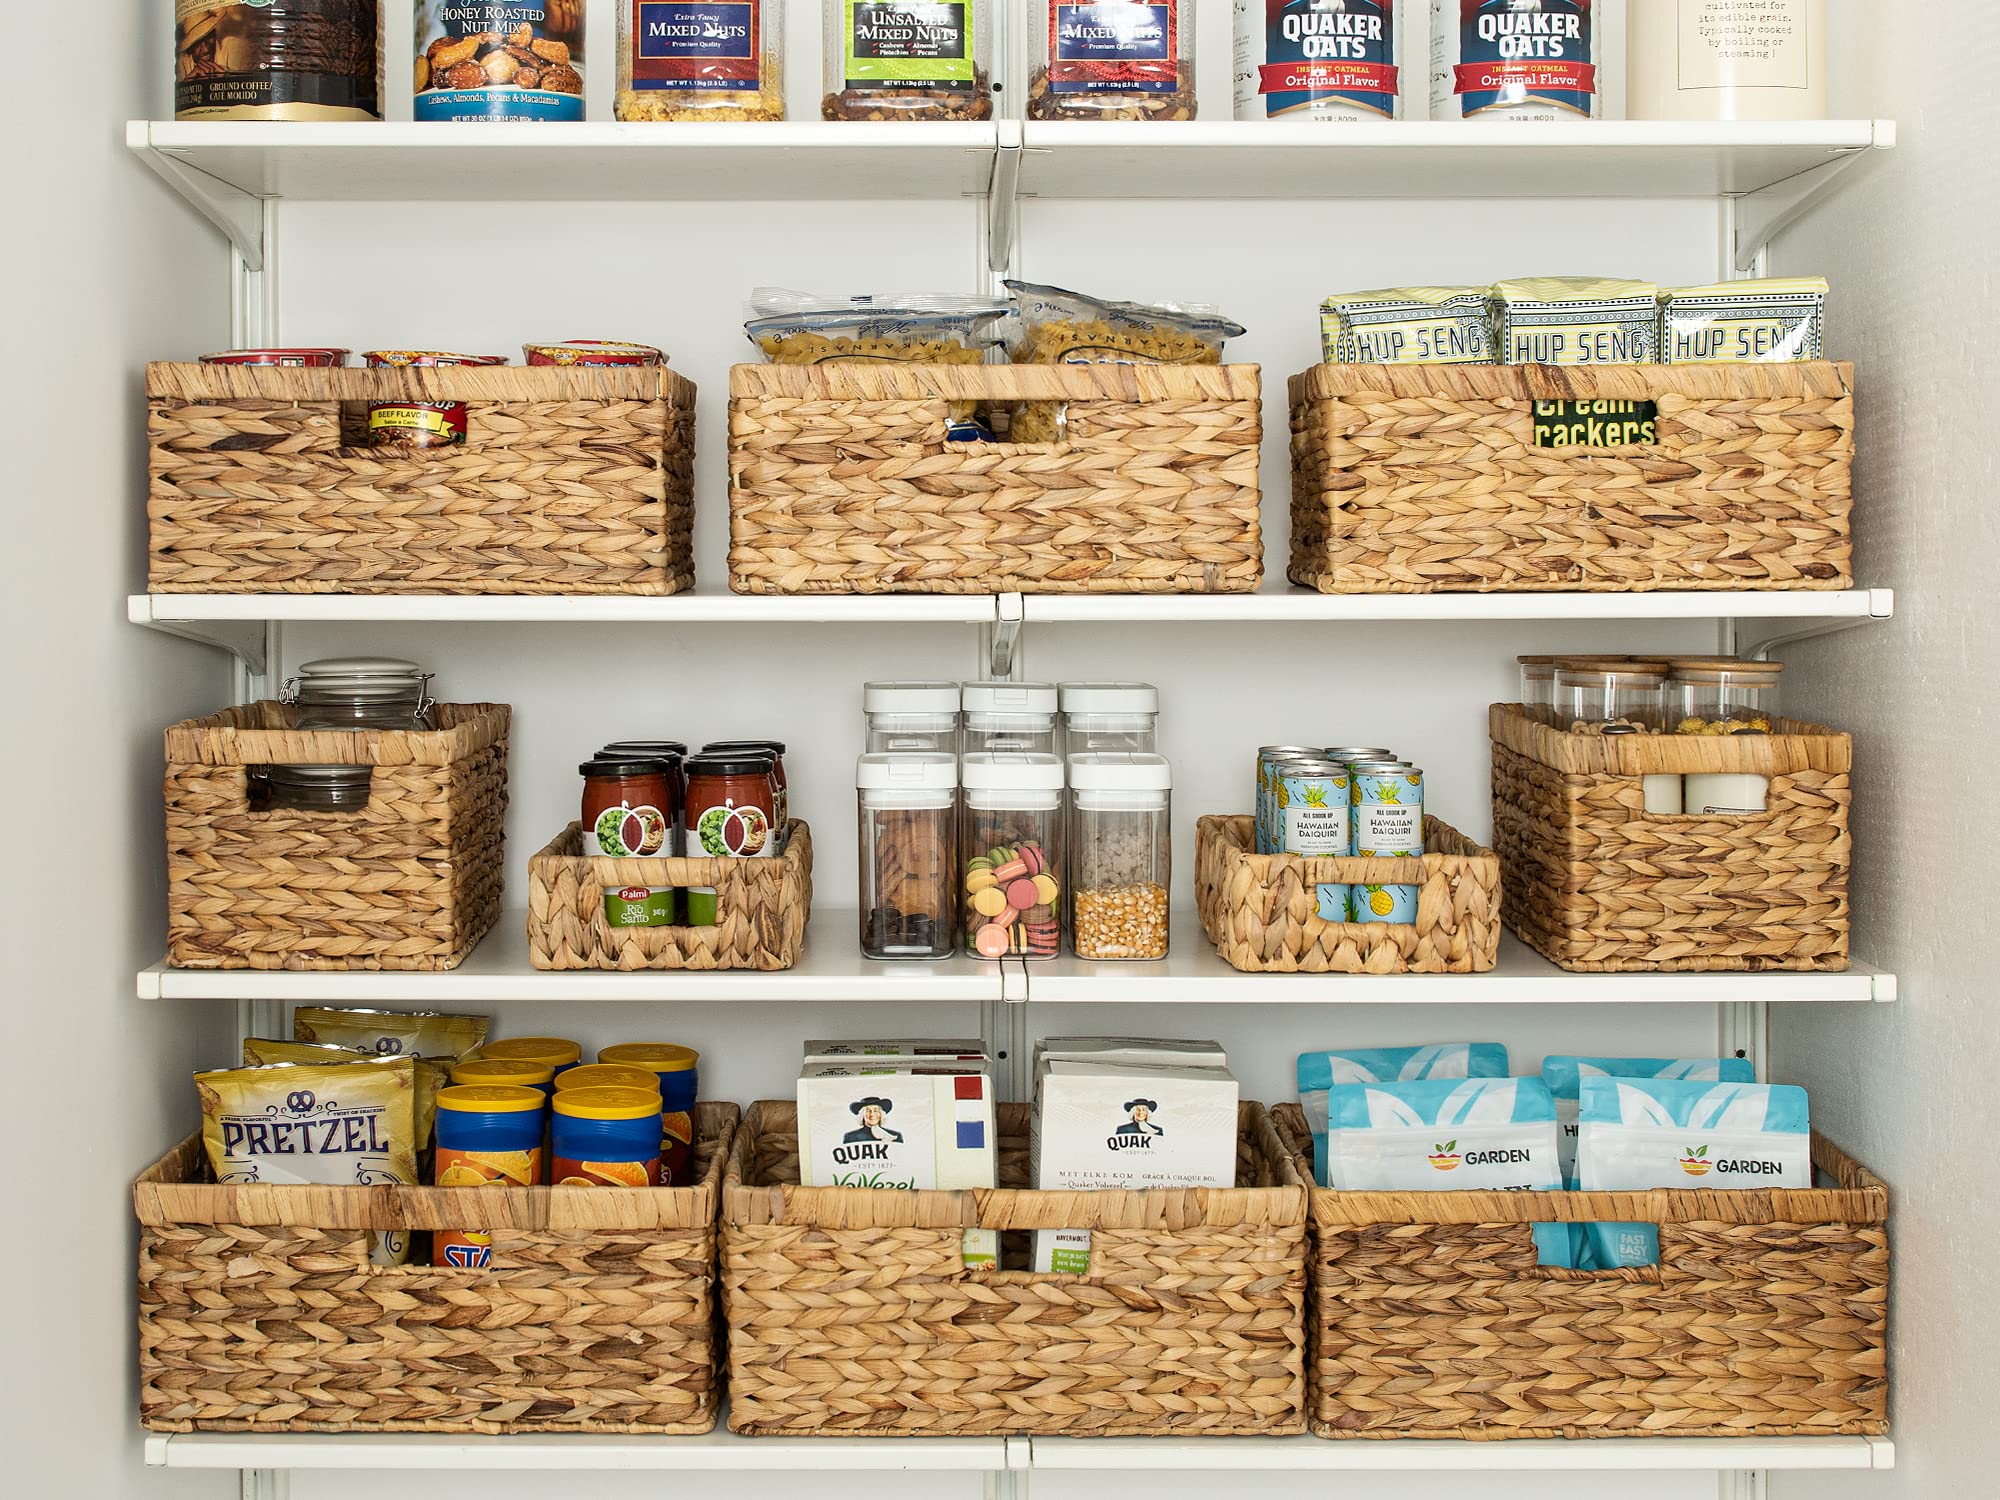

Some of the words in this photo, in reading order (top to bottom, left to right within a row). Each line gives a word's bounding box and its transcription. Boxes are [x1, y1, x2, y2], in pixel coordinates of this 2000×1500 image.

[1705, 2, 1766, 10] cultivated
[1770, 2, 1786, 10] for
[440, 8, 481, 21] HONEY
[484, 6, 545, 21] ROASTED
[697, 14, 720, 22] Fancy
[1718, 13, 1756, 21] edible
[1760, 14, 1792, 23] grain.
[461, 22, 490, 33] NUT
[495, 22, 521, 34] MIX
[649, 22, 700, 37] MIXED
[702, 22, 746, 38] NUTS
[860, 26, 913, 40] MIXED
[916, 26, 958, 40] NUTS
[1064, 24, 1116, 38] MIXED
[1282, 14, 1383, 42] QUAKER
[1478, 14, 1582, 42] QUAKER
[1698, 25, 1754, 36] Typically
[1758, 26, 1792, 34] cooked
[1302, 36, 1366, 59] OATS
[1498, 35, 1564, 58] OATS
[1708, 38, 1721, 48] by
[1724, 38, 1770, 47] boiling
[1296, 66, 1332, 74] INSTANT
[209, 82, 240, 91] GROUND
[1286, 75, 1340, 88] Original
[1344, 74, 1380, 88] Flavor
[1481, 74, 1536, 87] Original
[1540, 74, 1578, 86] Flavor
[227, 91, 257, 100] MOLIDO
[454, 93, 485, 102] Almonds,
[512, 94, 519, 102] &
[520, 94, 560, 106] Macadamias
[811, 342, 942, 353] MAKARNASI
[1060, 334, 1204, 350] MAKARNASI
[1356, 330, 1406, 362] HUP
[1416, 324, 1482, 360] SENG
[1516, 332, 1565, 364] HUP
[1577, 330, 1644, 364] SENG
[1675, 327, 1726, 360] HUP
[396, 411, 428, 419] FLAVOR
[1297, 822, 1339, 830] HAWAIIAN
[1299, 830, 1337, 838] DAIQUIRI
[622, 890, 647, 898] Palmi
[620, 914, 650, 924] Santo
[220, 1114, 390, 1156] PRETZEL
[1106, 1136, 1152, 1151] QUAK
[832, 1144, 889, 1165] QUAK
[1465, 1148, 1530, 1165] GARDEN
[1716, 1159, 1782, 1175] GARDEN
[1620, 1233, 1646, 1244] FAST
[1620, 1244, 1648, 1256] EASY
